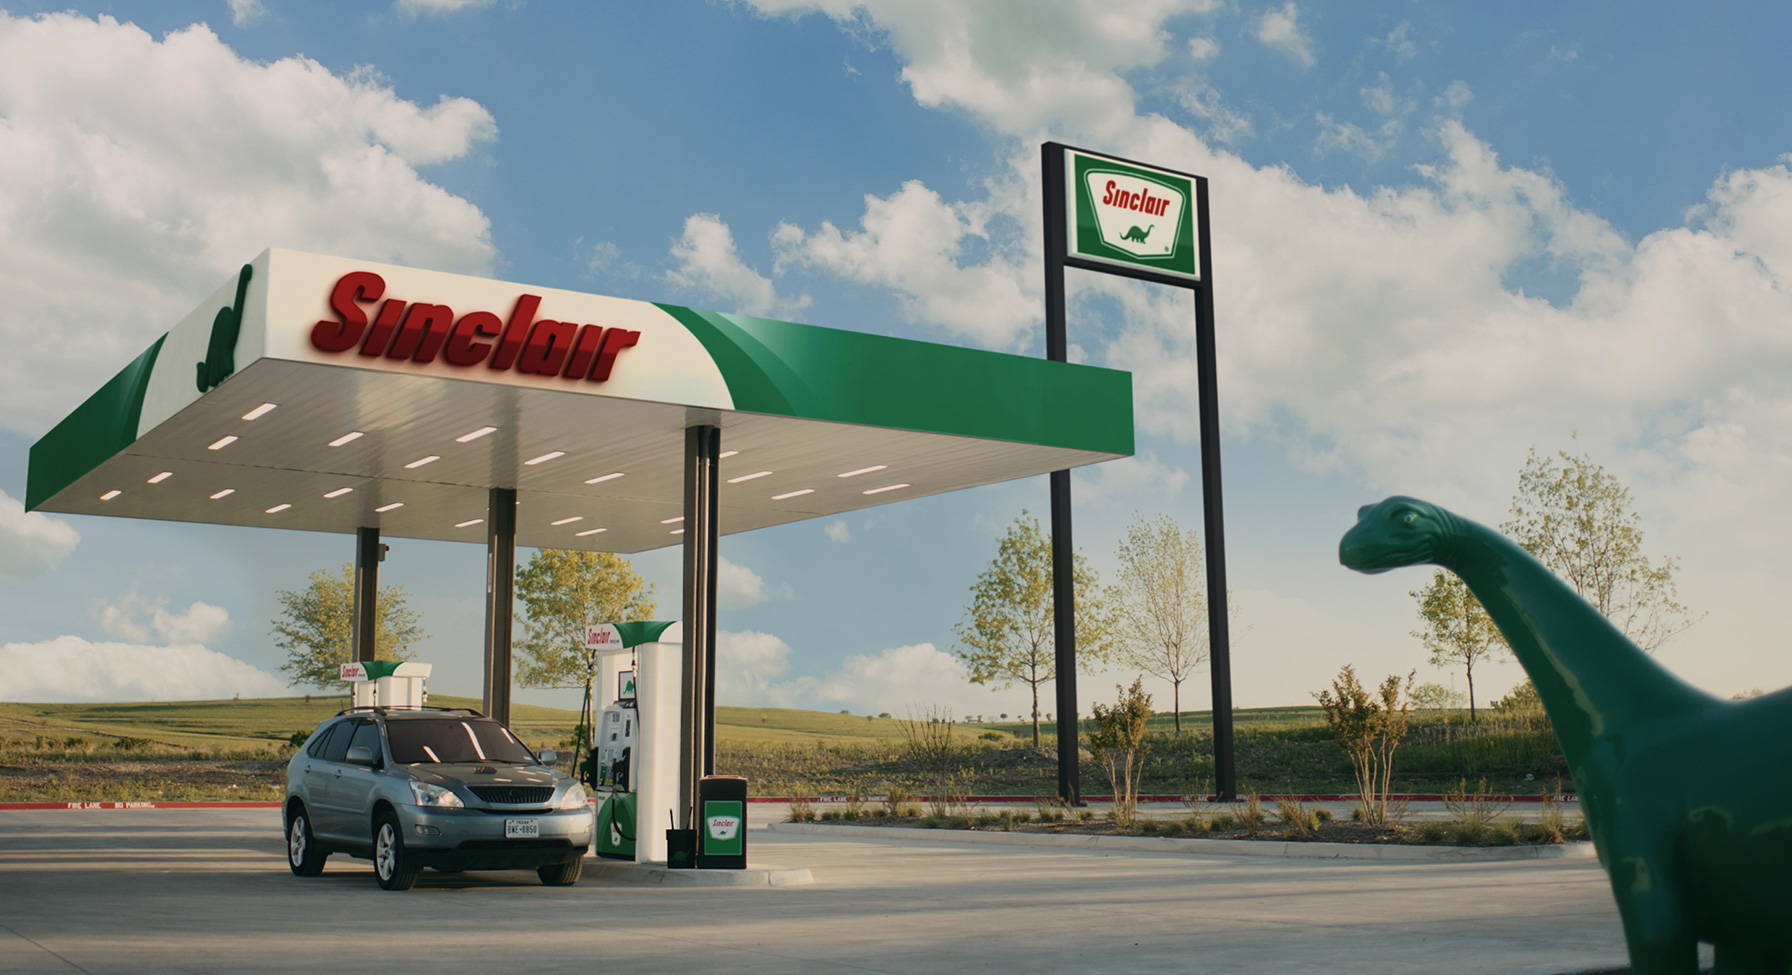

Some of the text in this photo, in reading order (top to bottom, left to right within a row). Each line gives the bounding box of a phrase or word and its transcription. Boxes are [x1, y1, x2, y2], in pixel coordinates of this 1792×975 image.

[1103, 180, 1170, 217] Sinclair
[310, 271, 642, 383] Sinclair
[587, 627, 611, 645] Sinclair
[341, 665, 359, 678] Sinclair
[67, 801, 82, 809] FIRE
[84, 801, 101, 809] LANE
[114, 801, 124, 809] NO
[712, 818, 735, 827] Sinclair
